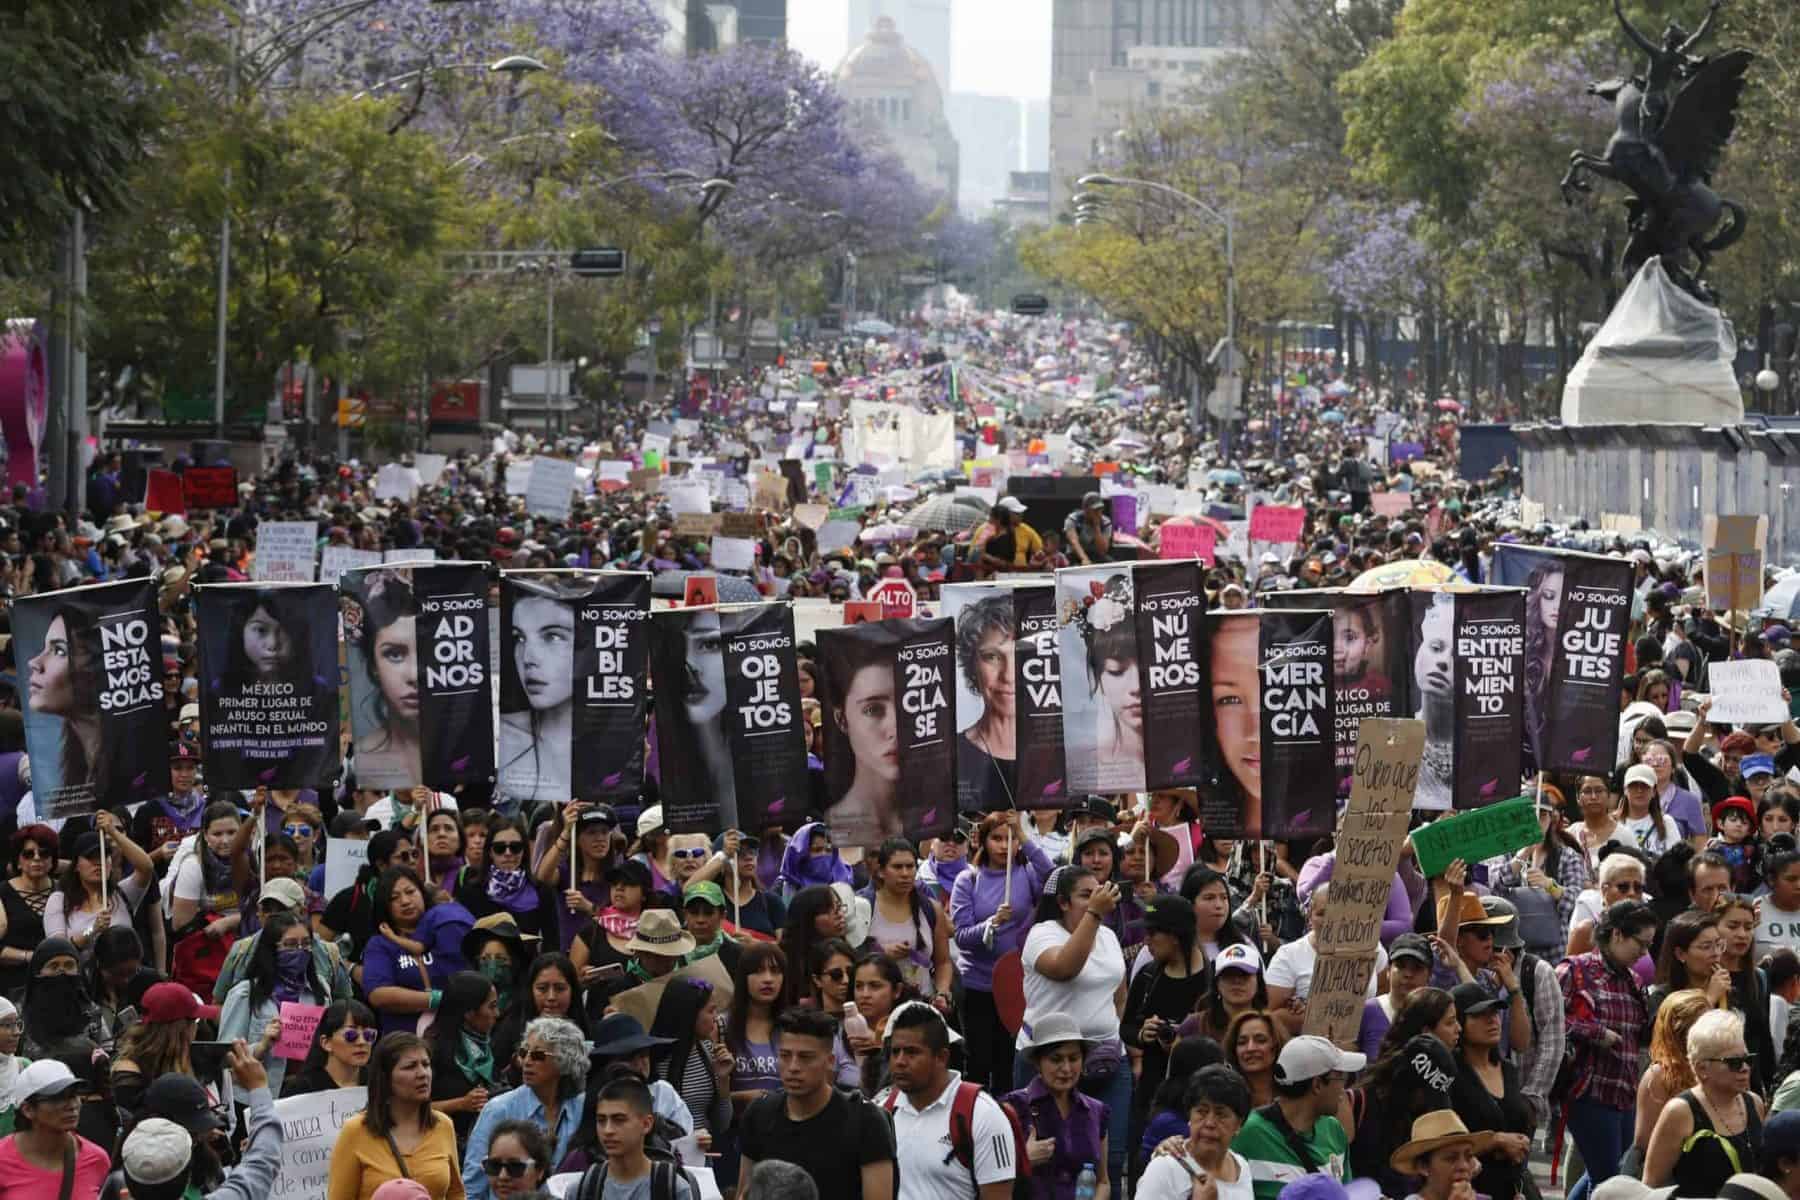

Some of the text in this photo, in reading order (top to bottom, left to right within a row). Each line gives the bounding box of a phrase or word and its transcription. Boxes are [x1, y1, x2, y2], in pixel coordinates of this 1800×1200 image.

[422, 599, 483, 612] NO SOMOS
[877, 590, 910, 605] ALTO
[1141, 596, 1199, 611] NO SOMOS
[1568, 591, 1627, 605] NO SOMOS
[581, 610, 644, 621] NO SOMOS
[1021, 621, 1038, 631] NO
[1152, 611, 1188, 638] NÚ
[1575, 607, 1611, 630] JU
[101, 620, 148, 650] NO
[434, 615, 474, 639] AD
[595, 625, 629, 648] DÉ
[1460, 625, 1520, 635] NO SOMOS
[434, 641, 474, 663] OR
[729, 637, 791, 652] NO SOMOS
[898, 645, 949, 662] NO SOMOS
[1155, 641, 1191, 663] ME
[1265, 645, 1327, 657] NO SOMOS
[1458, 637, 1523, 656] ENTRE
[1562, 631, 1621, 656] GUE
[104, 648, 150, 671] ESTA
[599, 651, 623, 673] BI
[741, 655, 781, 678] OB
[1468, 656, 1511, 676] TENI
[1565, 654, 1612, 679] TES
[108, 665, 152, 690] MOS
[426, 663, 484, 688] NOS
[905, 664, 943, 688] 2DA
[1149, 663, 1200, 689] ROS
[1266, 662, 1323, 685] MER
[100, 682, 163, 711] SOLAS
[242, 681, 294, 695] MÉXICO
[587, 676, 634, 698] LES
[749, 679, 780, 703] JE
[1027, 684, 1062, 708] VA
[1336, 689, 1369, 701] XICO
[1465, 676, 1514, 695] MIEN
[219, 696, 312, 708] PRIMER LUGAR DE
[902, 690, 947, 714] CLA
[1264, 687, 1326, 710] CAN
[1336, 702, 1391, 714] LUGAR DE
[1477, 695, 1503, 714] TO
[228, 710, 306, 721] ABUSO SEXUAL
[739, 703, 792, 729] TOS
[915, 712, 937, 738] SE
[1271, 712, 1320, 736] CÍA
[210, 722, 327, 735] INFANTIL EN EL MUNDO
[736, 1056, 778, 1072] SORR
